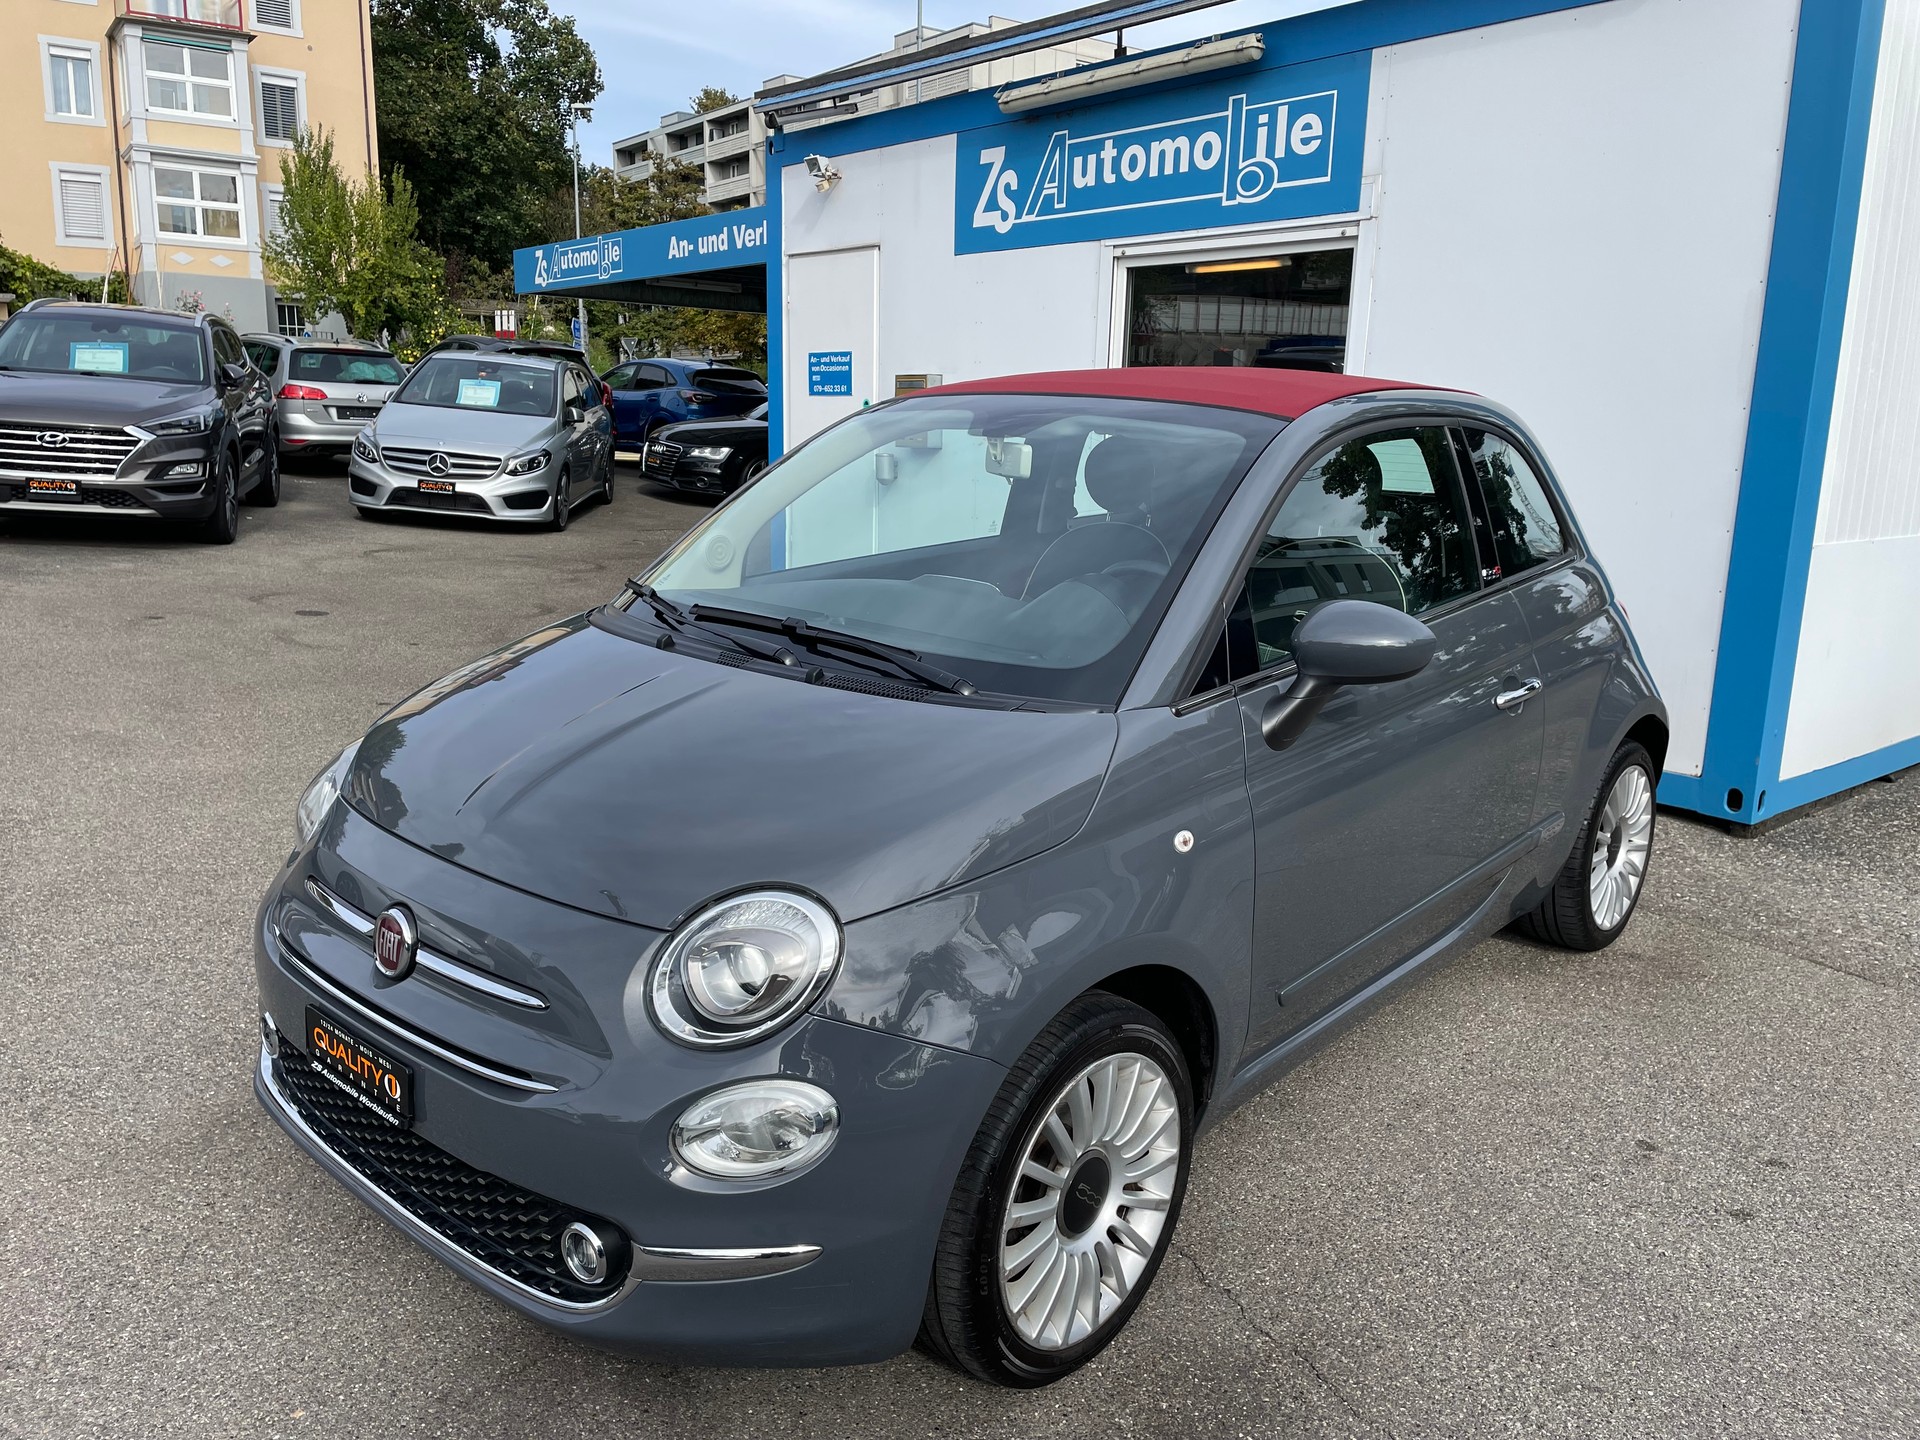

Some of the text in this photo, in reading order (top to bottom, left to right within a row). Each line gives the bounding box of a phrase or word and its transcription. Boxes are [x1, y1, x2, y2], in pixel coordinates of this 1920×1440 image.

[1023, 93, 1324, 221] Automobile
[550, 237, 620, 280] Automobile
[668, 235, 693, 260] An-
[698, 227, 728, 255] und
[820, 355, 830, 363] und
[830, 354, 850, 363] Verkauf
[820, 364, 849, 372] Occasionen
[29, 481, 67, 489] QUALITY
[379, 927, 401, 962] FIAT
[314, 1027, 383, 1086] QUALITY
[334, 1028, 354, 1046] MONATE
[360, 1045, 373, 1058] MOIS
[379, 1057, 392, 1070] MESI
[321, 1068, 359, 1098] Automobile
[359, 1094, 400, 1126] Worblaufen
[1076, 1183, 1102, 1208] 500
